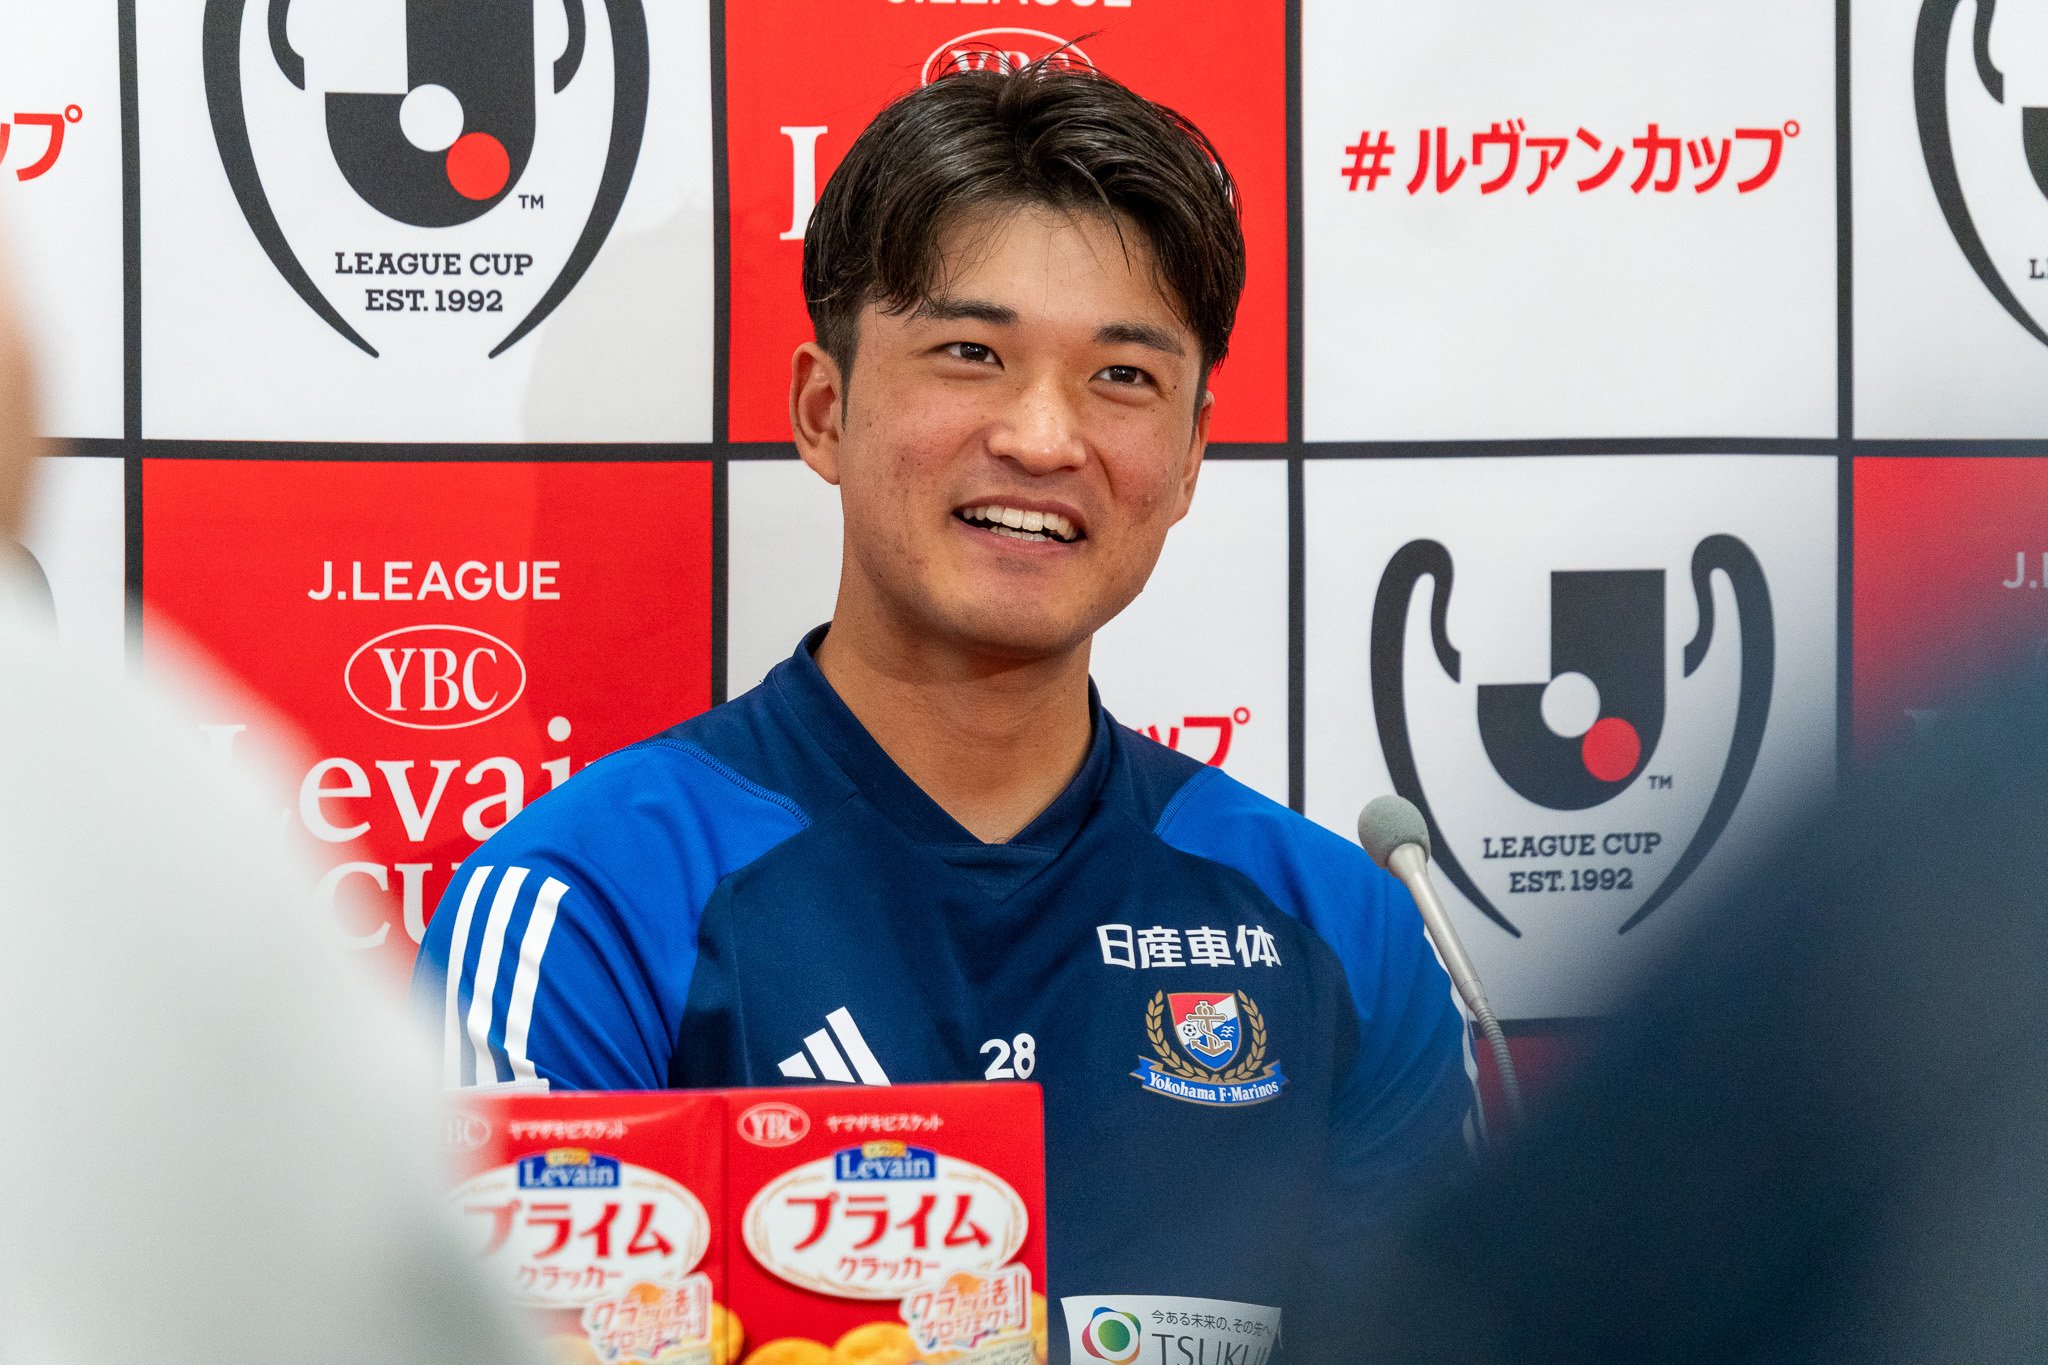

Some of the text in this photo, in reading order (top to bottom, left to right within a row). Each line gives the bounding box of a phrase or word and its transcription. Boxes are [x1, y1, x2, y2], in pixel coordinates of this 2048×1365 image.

[334, 251, 534, 277] LEAGUE CUP
[365, 288, 504, 313] EST. 1992
[307, 560, 561, 601] J.LEAGUE
[374, 647, 499, 712] YBC
[1483, 831, 1662, 860] LEAGUE CUP
[1509, 867, 1634, 894] EST. 1992
[1096, 923, 1282, 969] 日産車体
[979, 1032, 1035, 1081] 28
[1149, 1071, 1217, 1101] Yokohama
[523, 1160, 616, 1188] Levain
[840, 1152, 931, 1180] Levain
[464, 1199, 674, 1260] プライム
[786, 1191, 992, 1252] プライム
[519, 1264, 624, 1290] クラッカー
[837, 1256, 941, 1280] クラッカー
